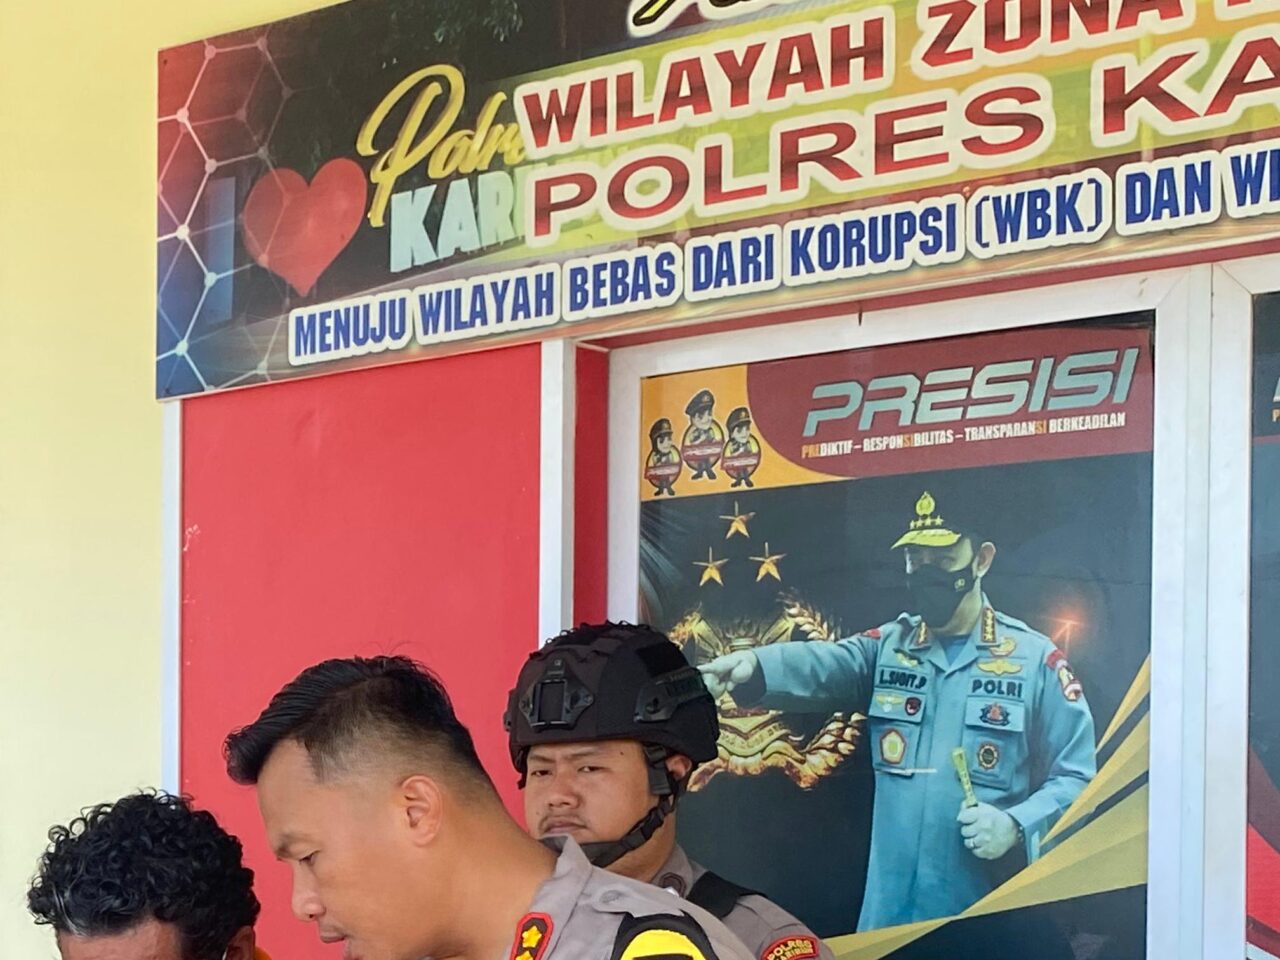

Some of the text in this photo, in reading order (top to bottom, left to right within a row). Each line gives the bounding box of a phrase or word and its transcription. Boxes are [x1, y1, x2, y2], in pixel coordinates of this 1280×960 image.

[523, 17, 884, 149] WILAYAH
[534, 86, 1043, 237] POLRES
[295, 297, 407, 358] MENUJU
[419, 271, 555, 335] WILAYAH
[569, 250, 676, 313] BEBAS
[692, 233, 774, 292] DARI
[790, 203, 956, 277] KORUPSI
[975, 178, 1103, 248] (WBK)
[1125, 159, 1212, 225] DAN
[802, 348, 1139, 437] PRESISI
[802, 412, 1126, 458] PREDIKTIF RESPONSIBILITAS TRANSPARANSI BERKEADILAN
[972, 678, 1023, 698] POLRI
